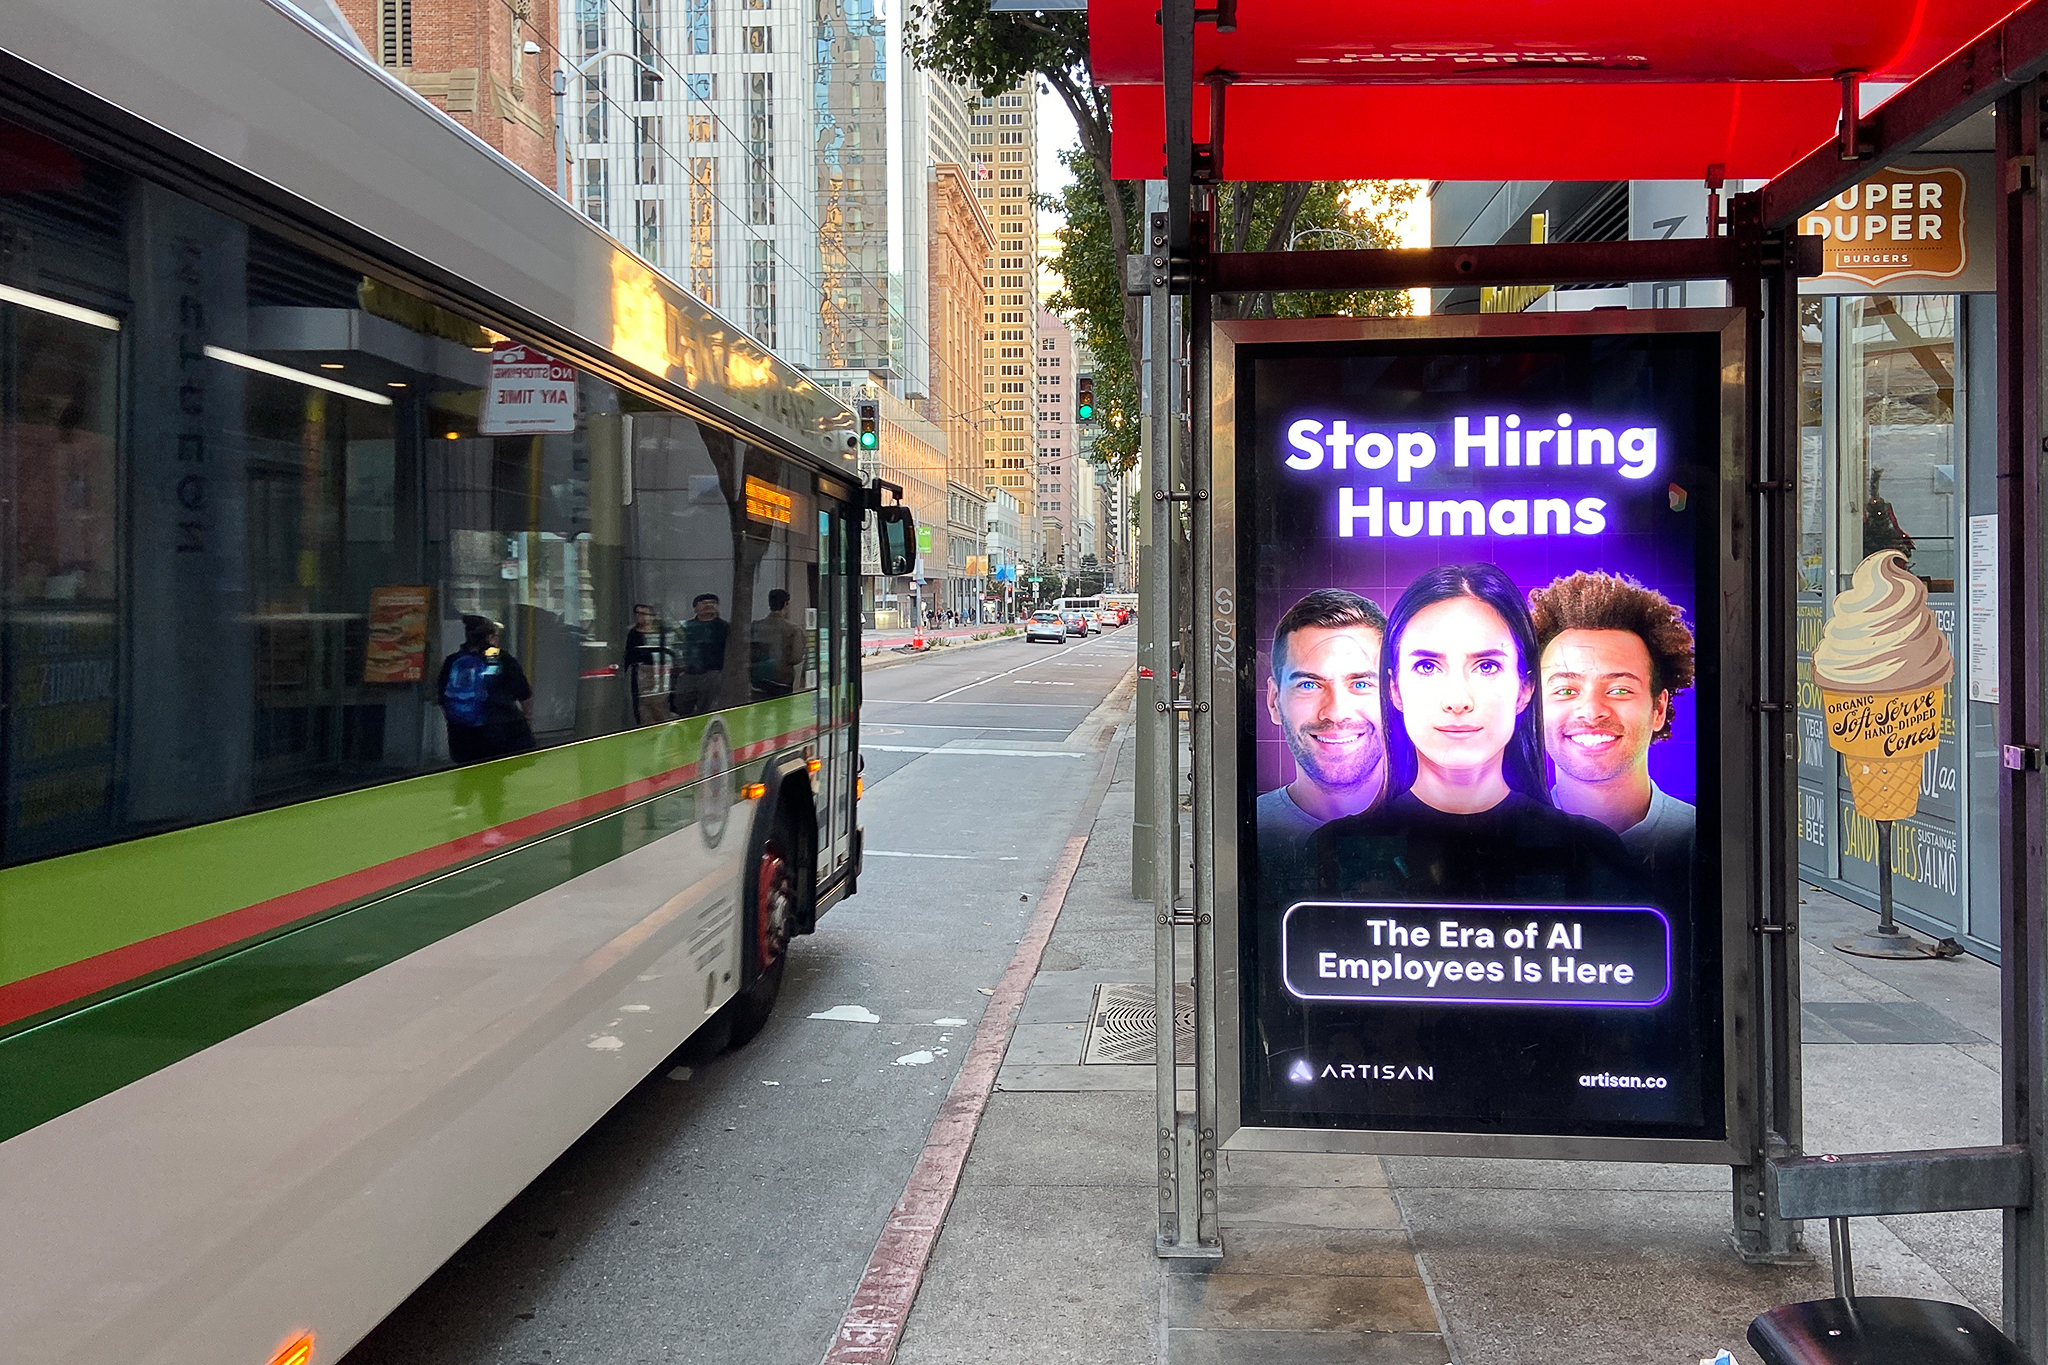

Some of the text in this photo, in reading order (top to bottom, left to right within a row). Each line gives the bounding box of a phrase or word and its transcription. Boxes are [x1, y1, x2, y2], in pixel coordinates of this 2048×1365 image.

[1814, 183, 1942, 210] UPER
[1807, 214, 1942, 241] DUPER
[1843, 254, 1909, 263] BURGERS
[1284, 412, 1658, 482] Stop Hiring
[1338, 486, 1608, 538] Humans
[1828, 695, 1874, 714] ORGANIC
[1833, 707, 1876, 742] Soft
[1875, 691, 1935, 726] Serve
[1864, 708, 1936, 740] HAND-DIPPED
[1884, 722, 1939, 757] Cones
[1844, 806, 1917, 881] SANDCHES
[1367, 919, 1582, 950] The Era of AI
[1318, 952, 1635, 988] Employees Is Here
[1321, 1063, 1434, 1081] ARTISAN
[1578, 1073, 1668, 1090] artisan.co
